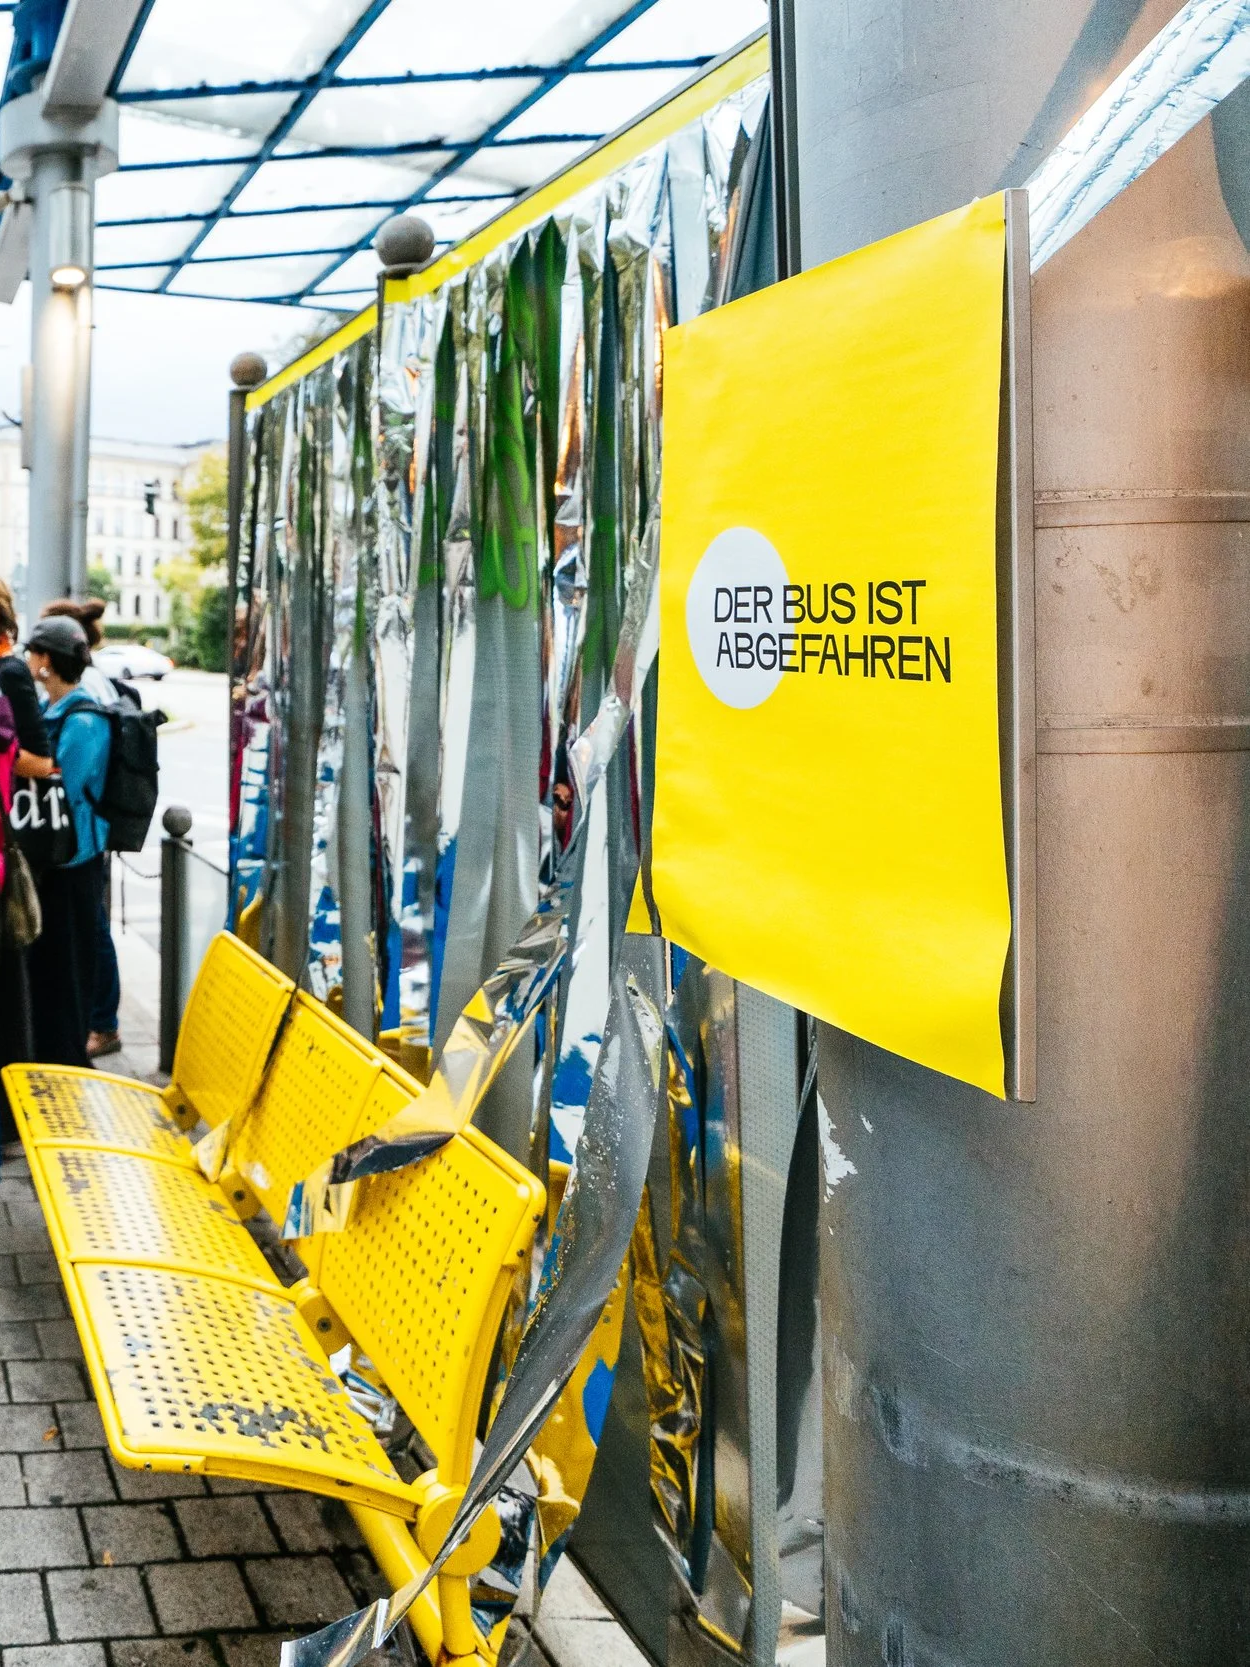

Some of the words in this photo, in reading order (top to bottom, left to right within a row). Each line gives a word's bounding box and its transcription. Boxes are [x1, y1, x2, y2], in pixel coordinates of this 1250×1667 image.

[714, 586, 773, 624] DER
[783, 583, 856, 625] BUS
[868, 580, 927, 625] IST
[716, 632, 951, 683] ABGEFAHREN
